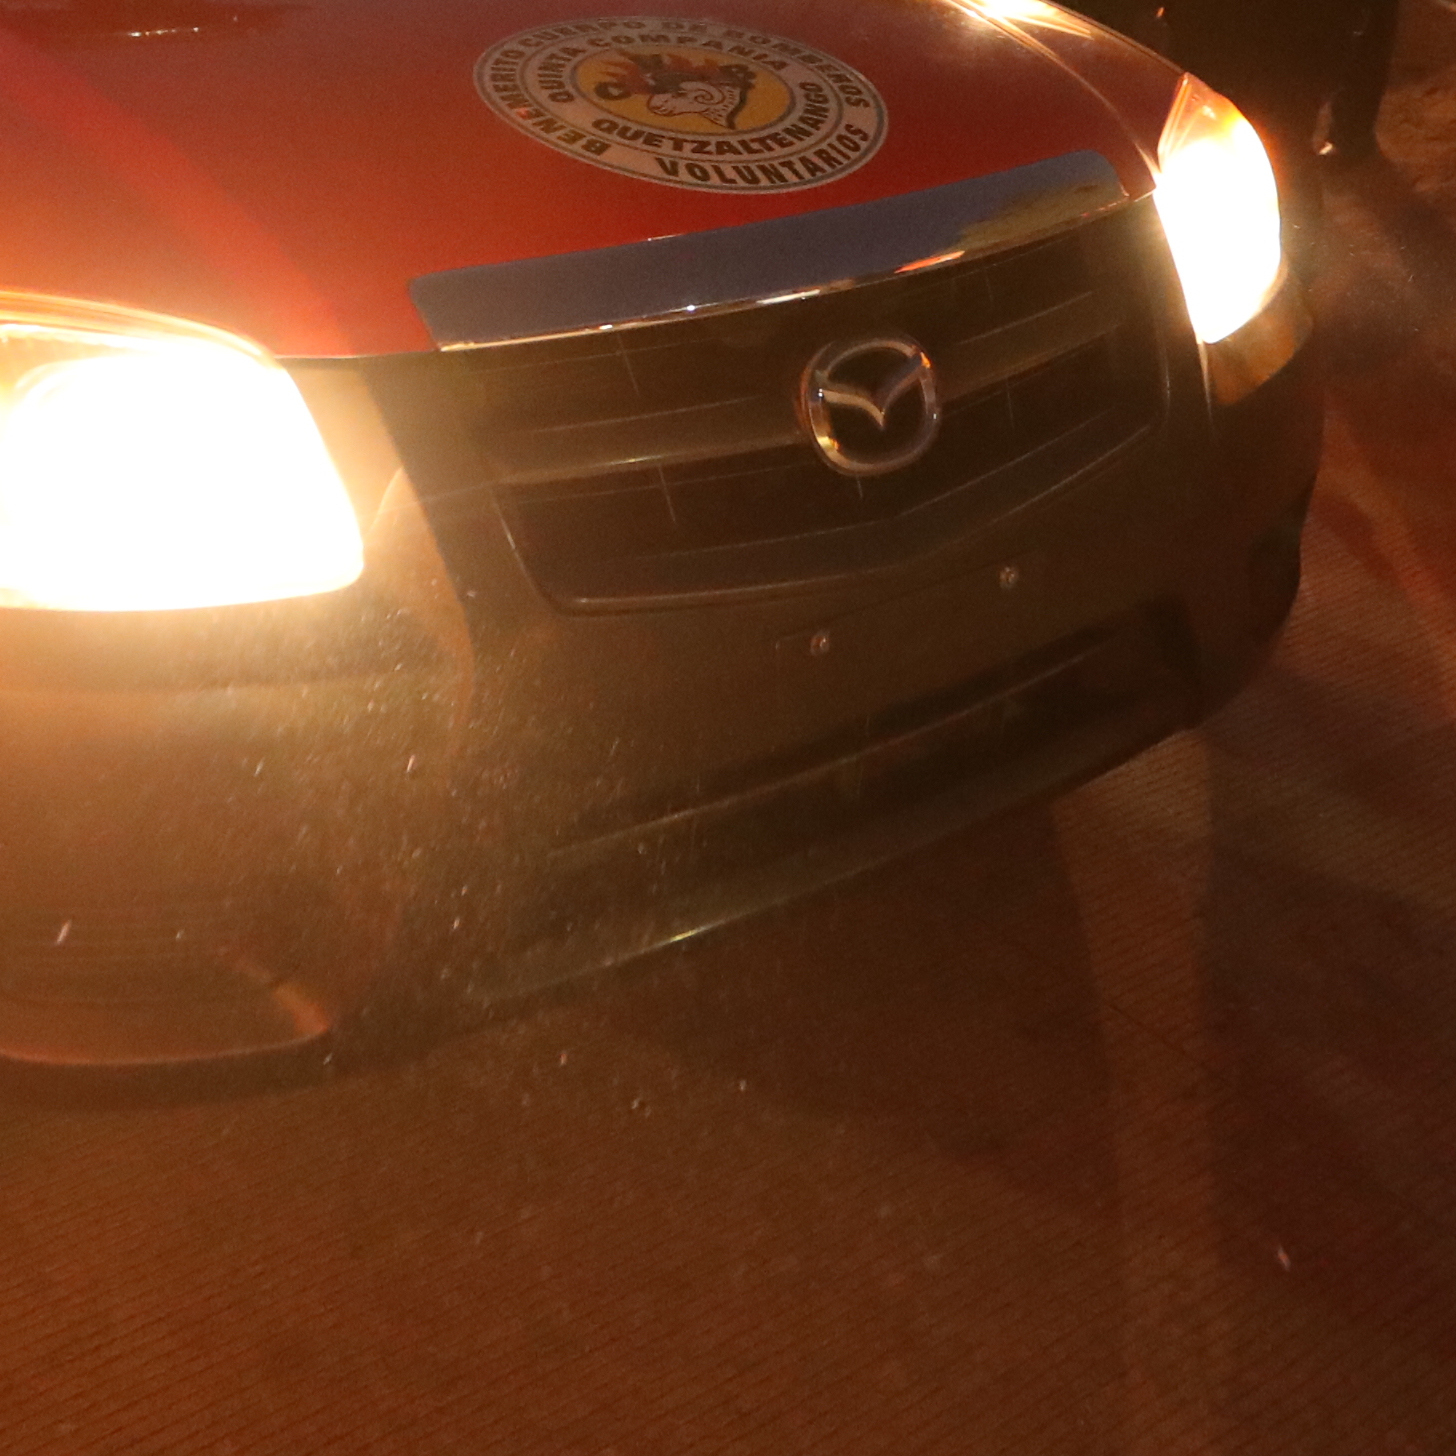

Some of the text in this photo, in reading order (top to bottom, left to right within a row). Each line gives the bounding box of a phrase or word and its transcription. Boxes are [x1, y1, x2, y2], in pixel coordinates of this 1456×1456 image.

[491, 21, 870, 156] BENEMERITO CUERPO DE BOMBEROS
[538, 47, 586, 103] QUINTA
[592, 81, 830, 156] QUETZALTENANGO
[654, 124, 869, 185] VOLUNTARIOS
